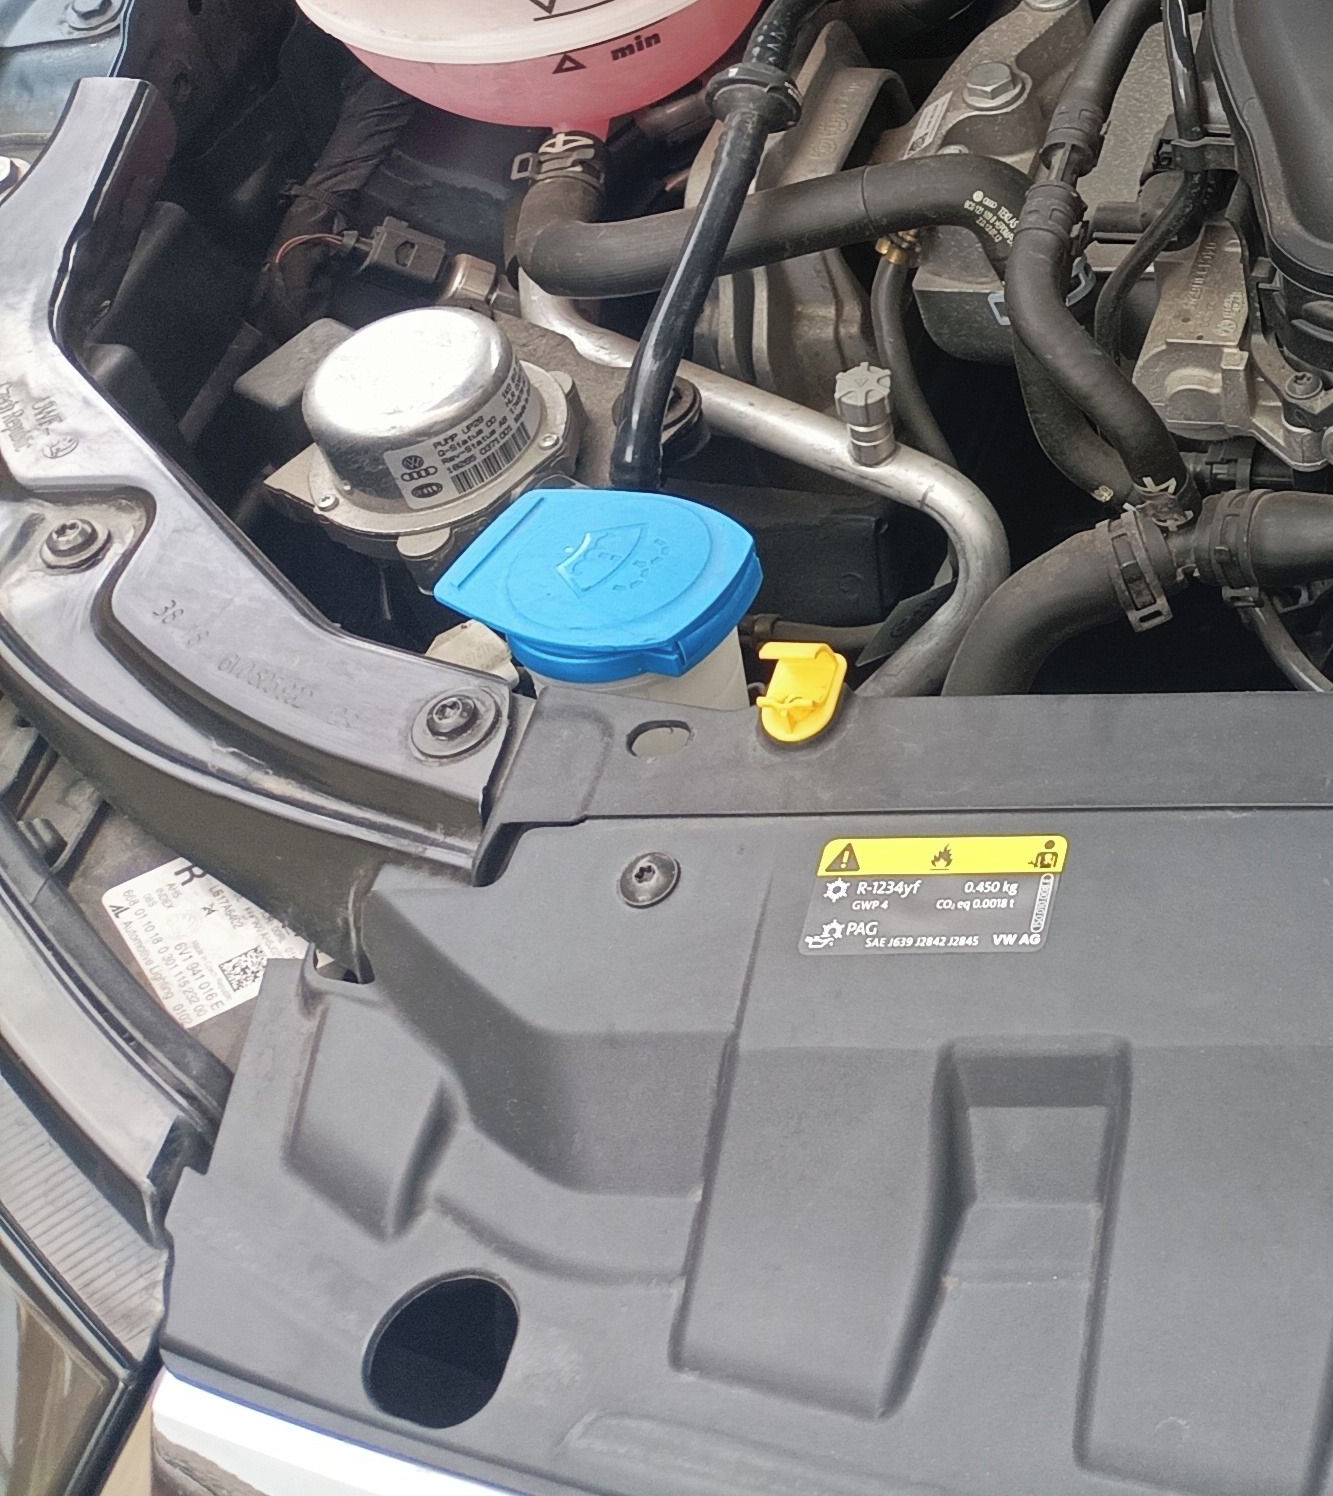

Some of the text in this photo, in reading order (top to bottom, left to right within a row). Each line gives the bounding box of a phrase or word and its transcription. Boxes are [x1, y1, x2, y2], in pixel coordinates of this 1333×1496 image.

[610, 33, 661, 61] min
[431, 430, 459, 451] PUMP
[857, 880, 1018, 898] R-1234yf 0.450 kg
[852, 900, 879, 911] GWP
[881, 900, 888, 910] 4
[957, 900, 970, 912] eq
[846, 922, 878, 936] PAG
[865, 937, 886, 948] SAE
[888, 936, 913, 948] J639
[993, 934, 1017, 946] VW
[1019, 934, 1041, 945] AG
[120, 920, 155, 966] Automotive
[147, 965, 176, 1000] Lighting
